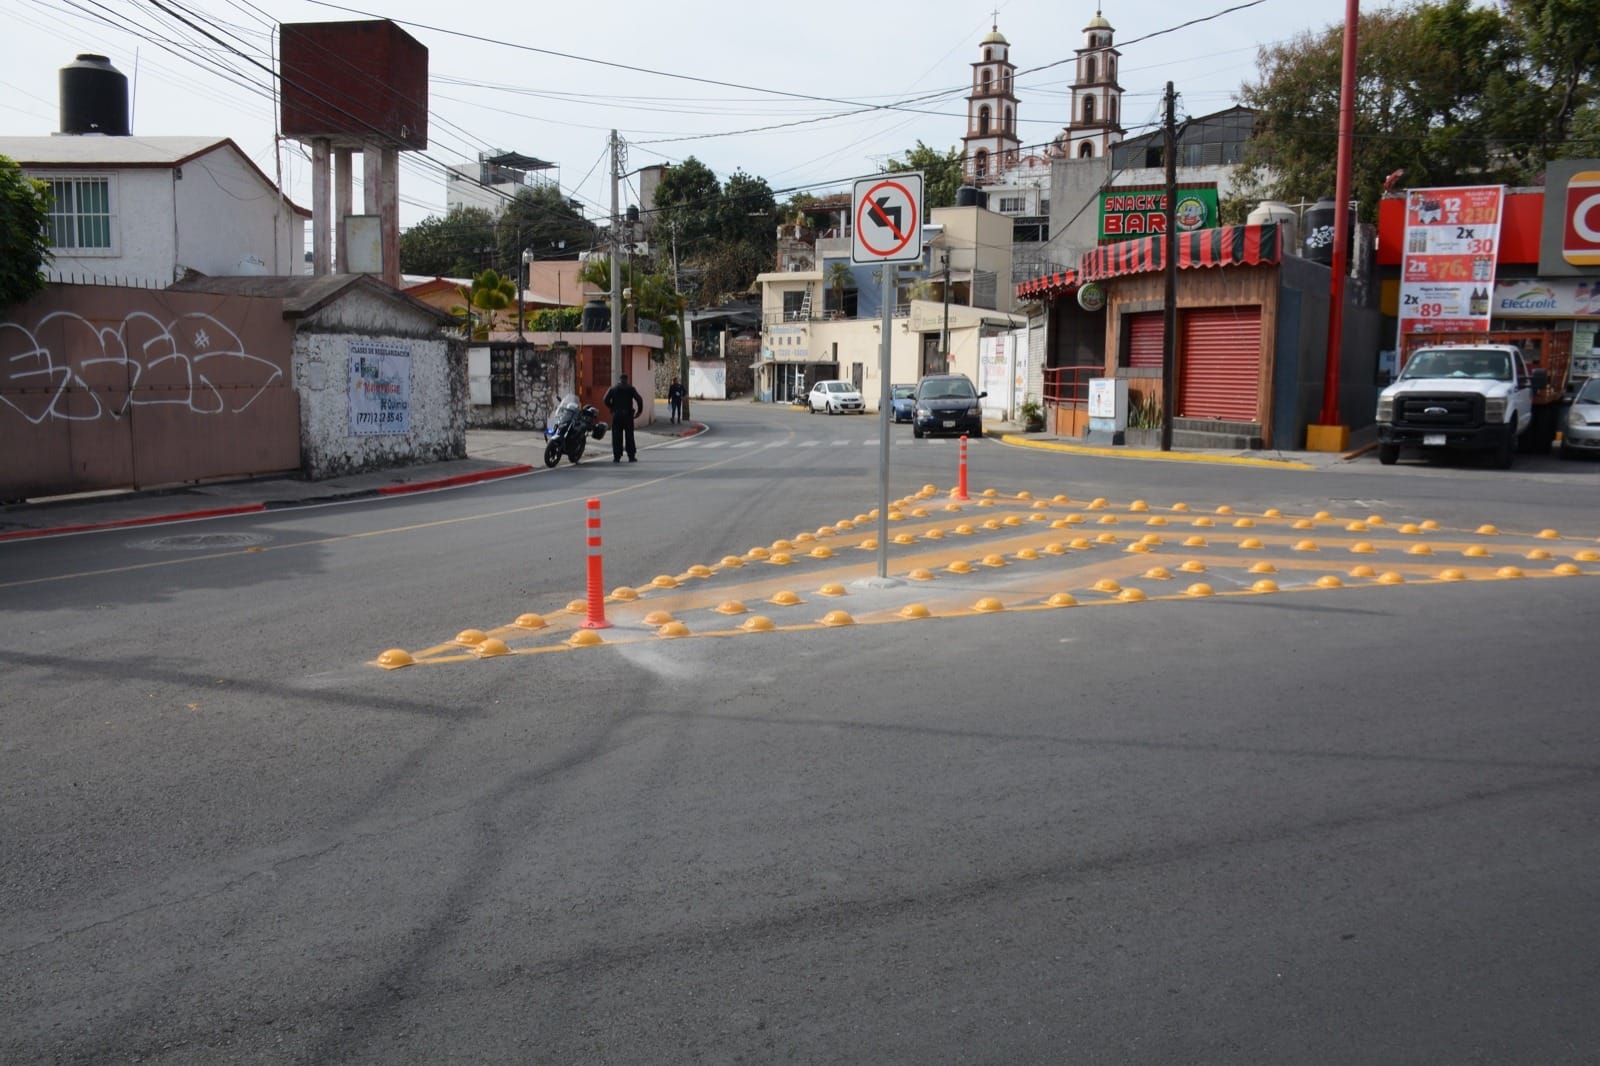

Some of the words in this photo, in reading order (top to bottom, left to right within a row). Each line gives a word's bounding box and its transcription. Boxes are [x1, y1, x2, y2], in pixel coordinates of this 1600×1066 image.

[1104, 194, 1167, 211] SNACK'S
[1444, 198, 1461, 212] 12
[1104, 212, 1167, 235] BAR
[1456, 227, 1474, 239] 2x
[1467, 239, 1493, 253] $30
[1403, 294, 1419, 305] 2x
[1501, 299, 1557, 309] Electrolit
